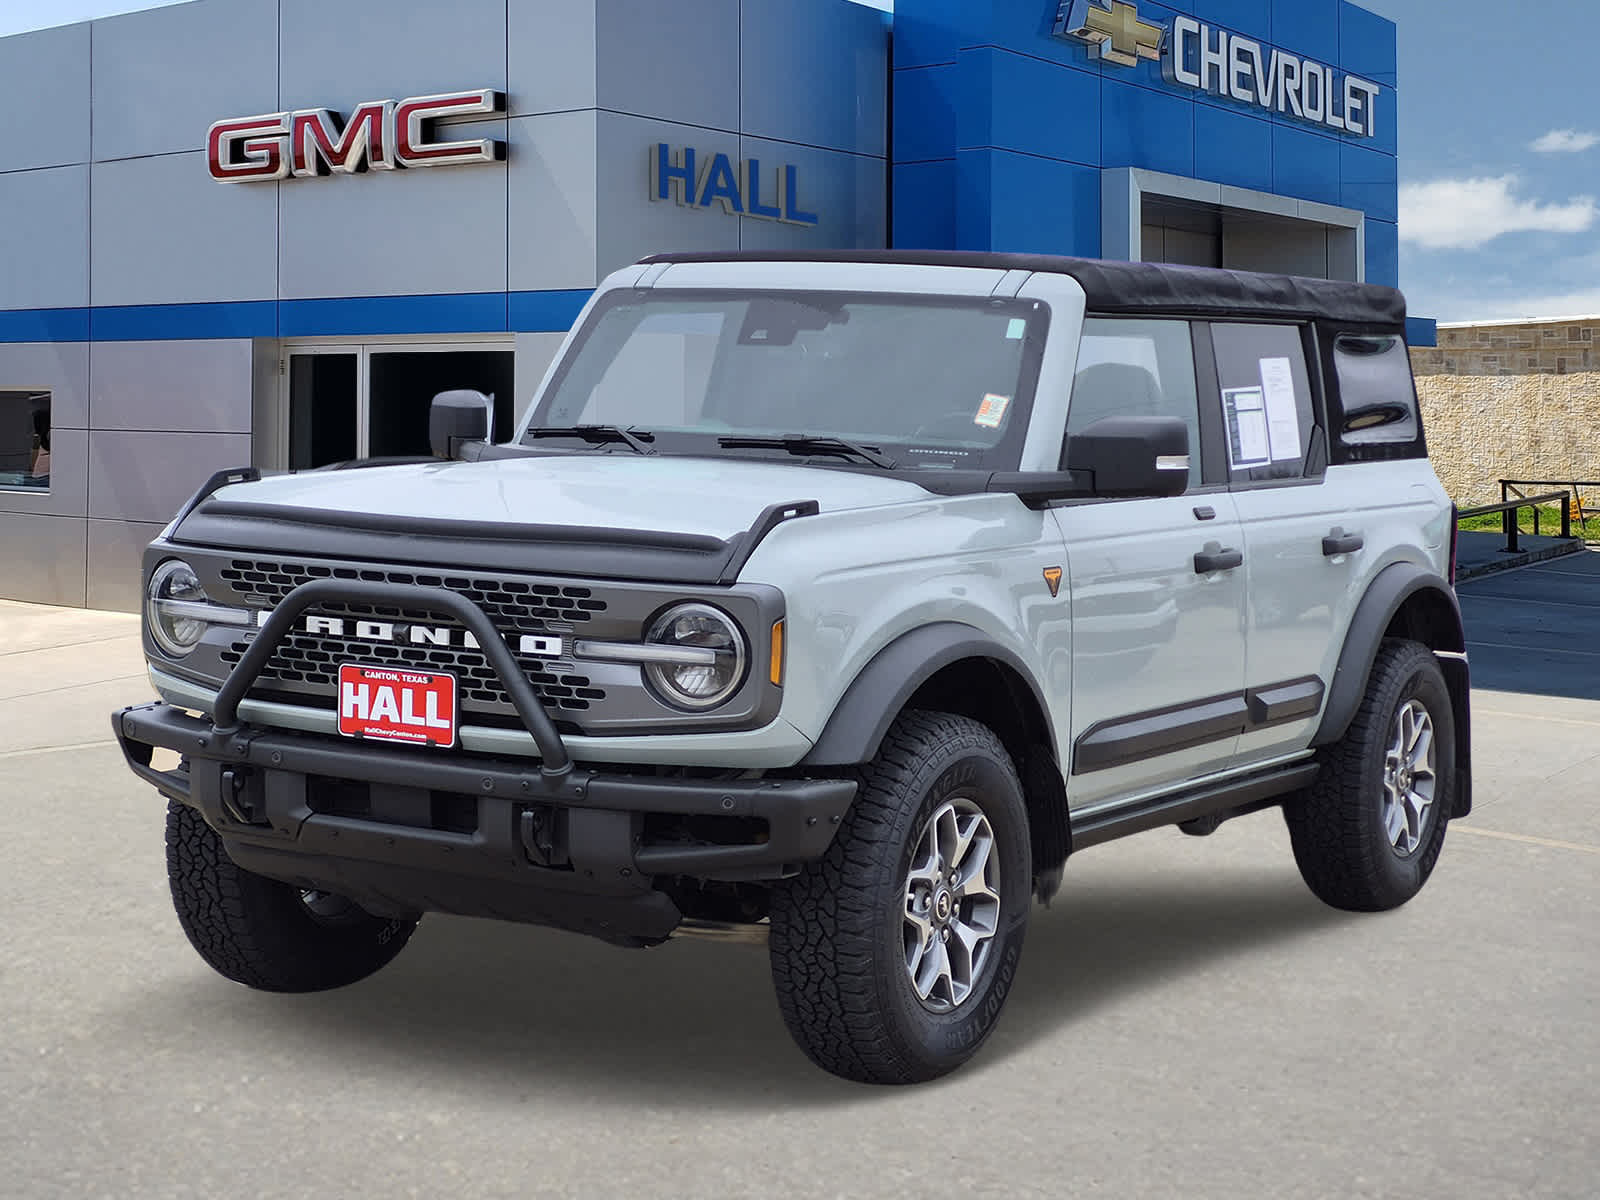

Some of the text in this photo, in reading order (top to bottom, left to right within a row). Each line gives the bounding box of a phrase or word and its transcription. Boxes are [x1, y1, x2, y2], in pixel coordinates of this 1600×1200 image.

[1172, 14, 1380, 138] CHEVROLET
[205, 88, 507, 184] GMC
[651, 143, 819, 226] HALL
[342, 681, 450, 729] HALL
[364, 670, 428, 684] CANTON, TEXAS
